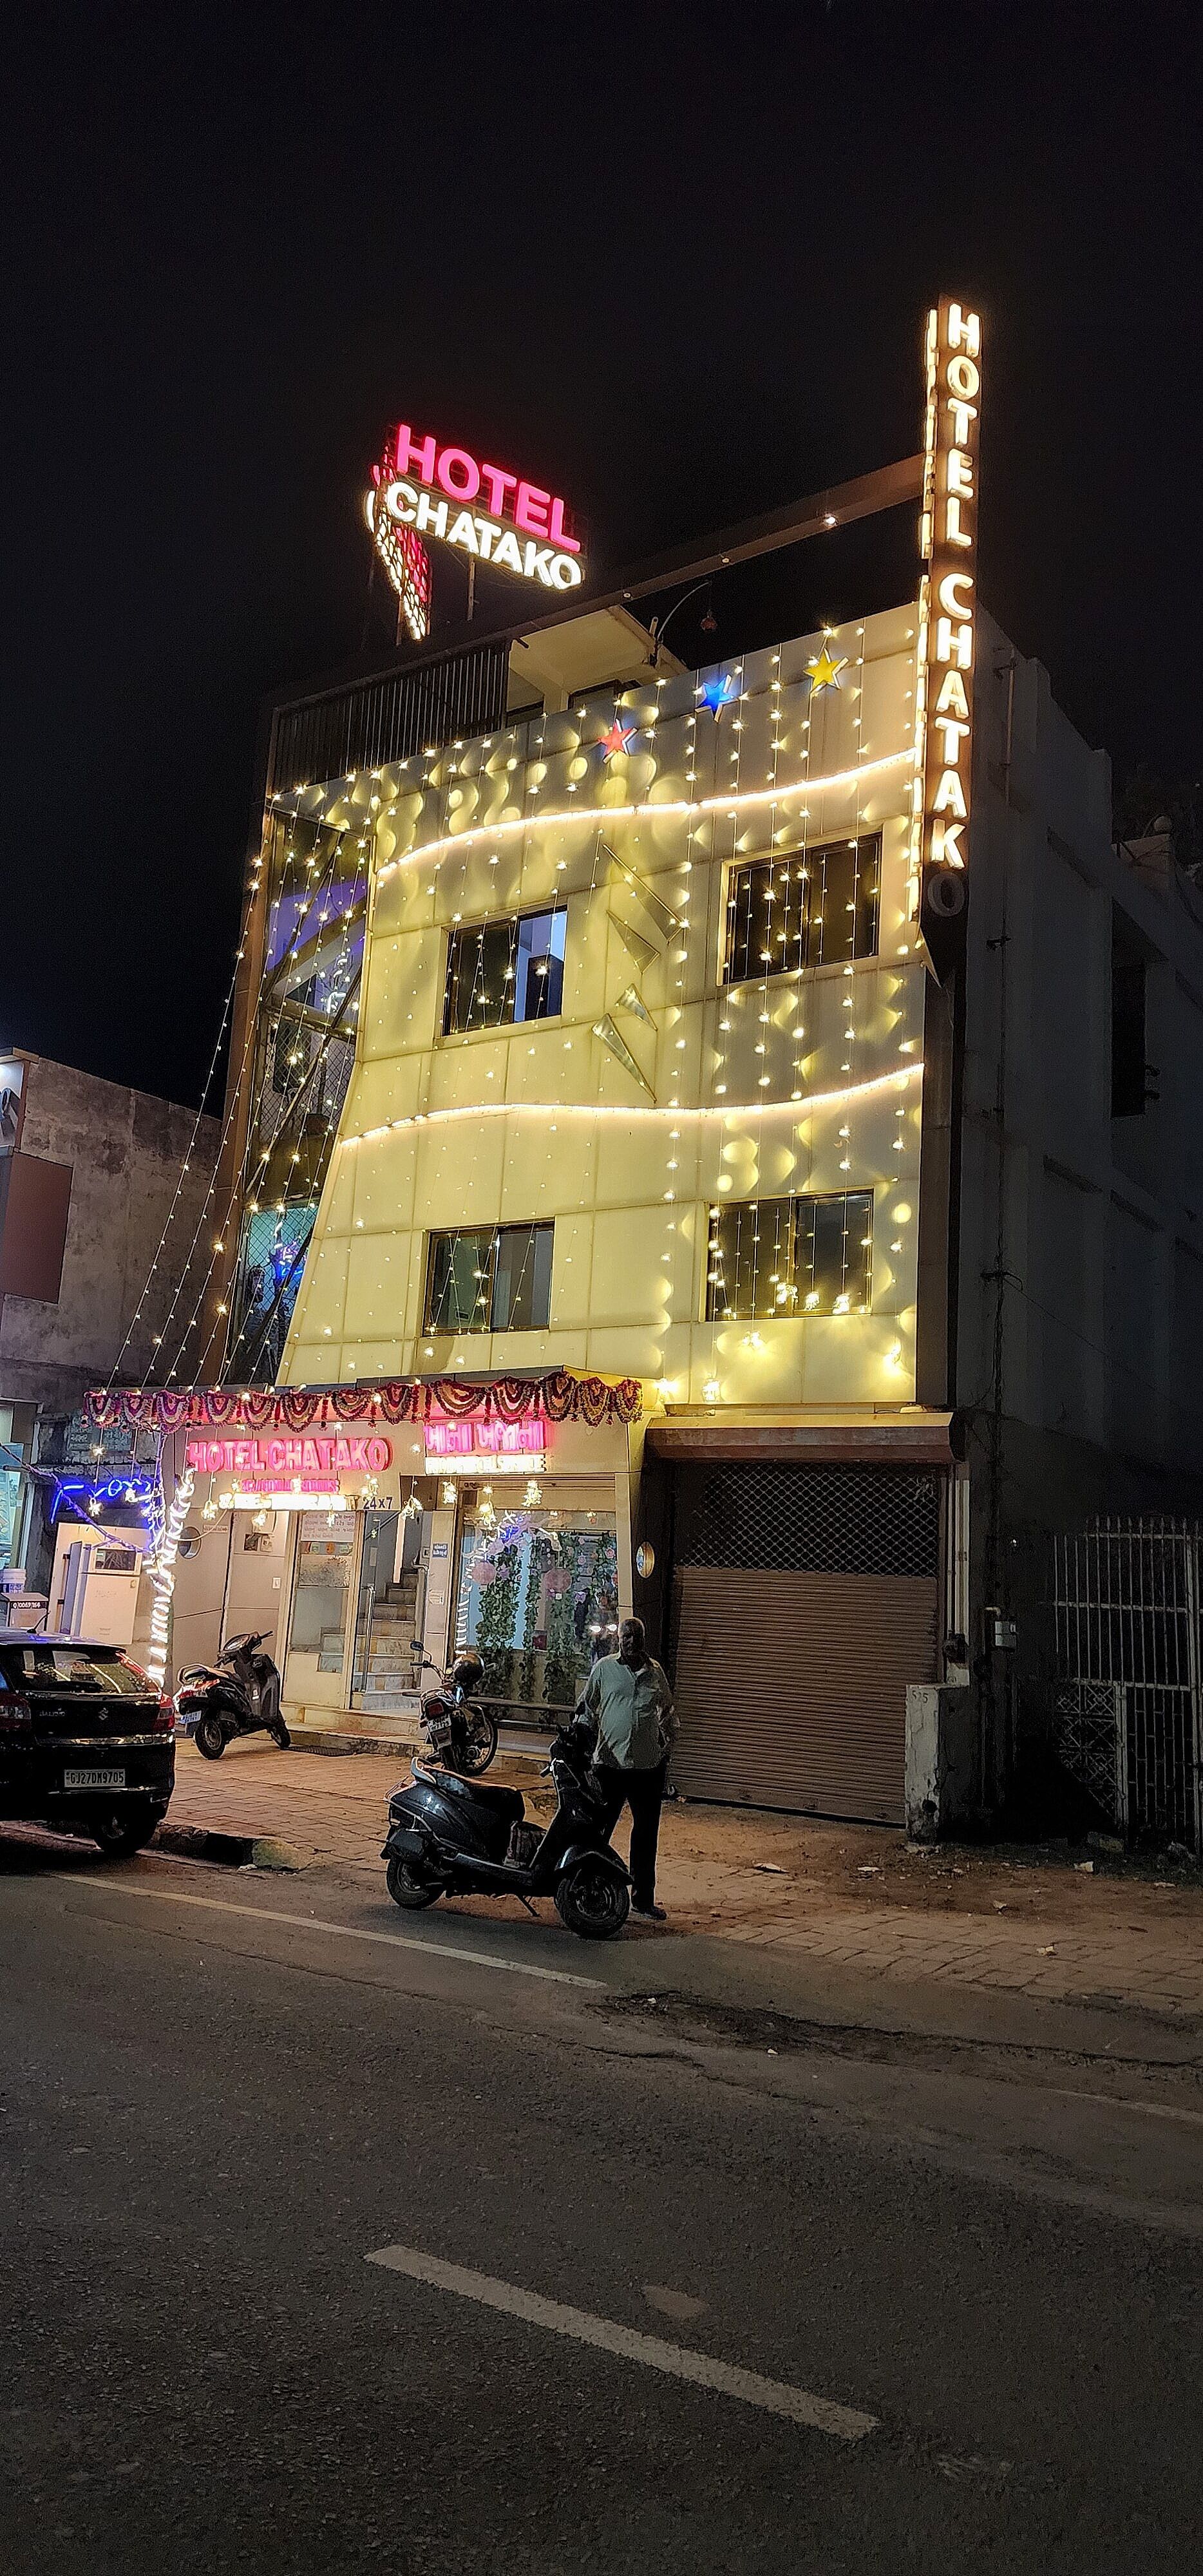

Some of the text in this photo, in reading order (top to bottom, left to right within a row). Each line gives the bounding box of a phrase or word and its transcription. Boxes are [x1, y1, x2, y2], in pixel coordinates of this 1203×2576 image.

[386, 481, 582, 590] CHATAKO
[395, 424, 582, 552] HOTEL
[927, 303, 981, 918] HOTEL CHATAKO
[189, 1439, 267, 1472] HOTEL
[267, 1437, 393, 1472] CHATAKO
